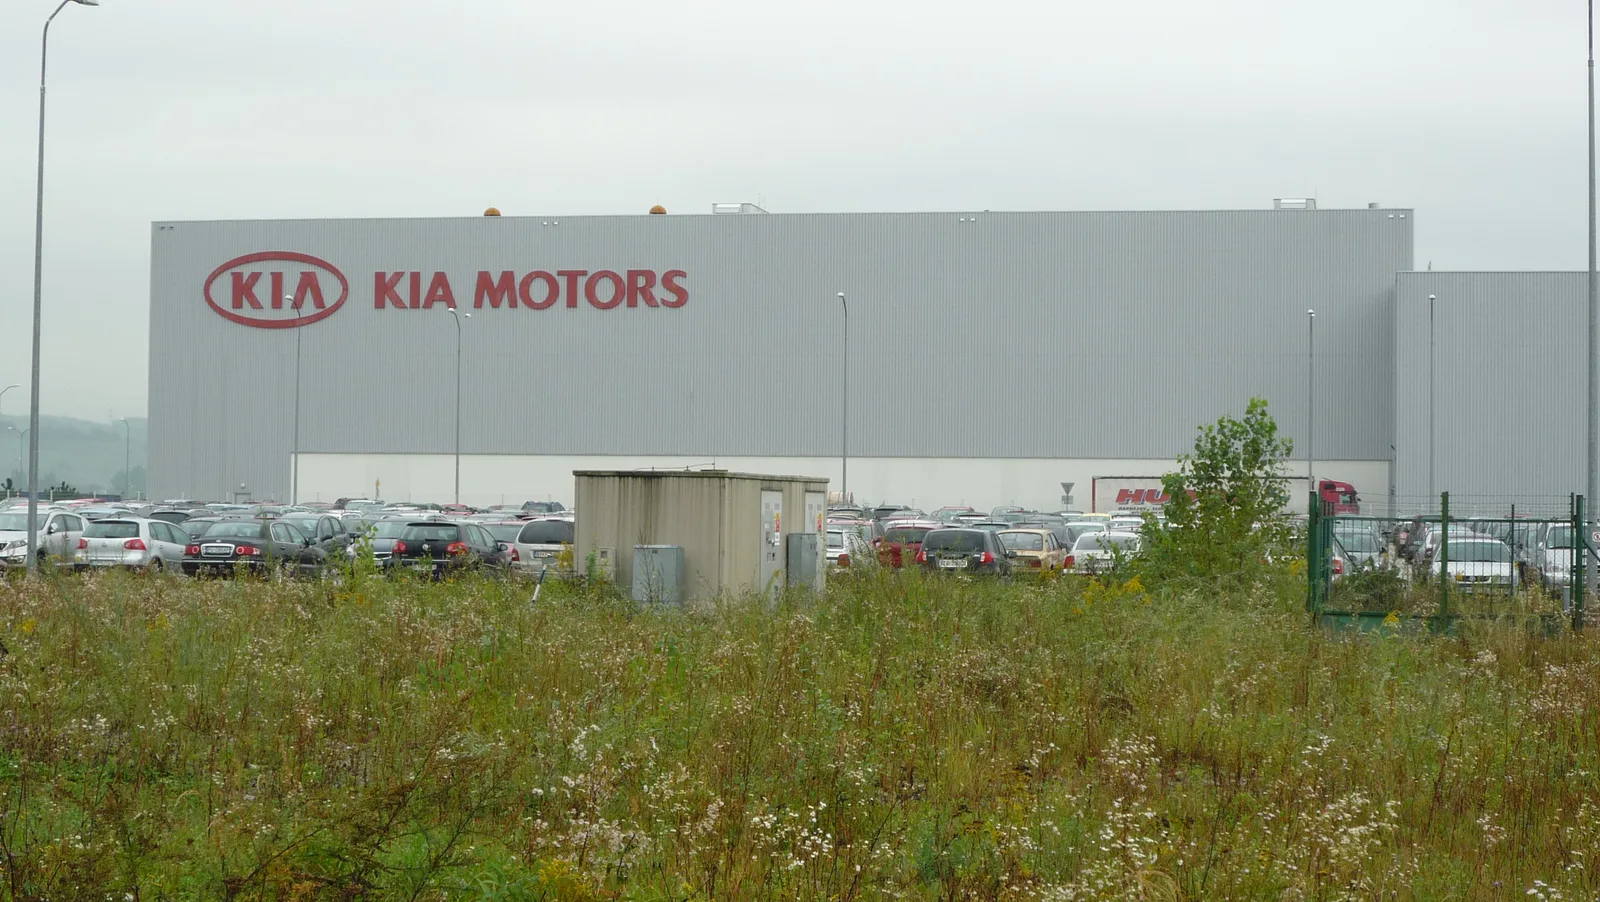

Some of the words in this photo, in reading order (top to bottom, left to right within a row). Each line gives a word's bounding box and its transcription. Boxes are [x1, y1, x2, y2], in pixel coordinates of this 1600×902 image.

[230, 271, 327, 309] KIA
[374, 271, 457, 309] KIA
[473, 269, 689, 310] MOTORS
